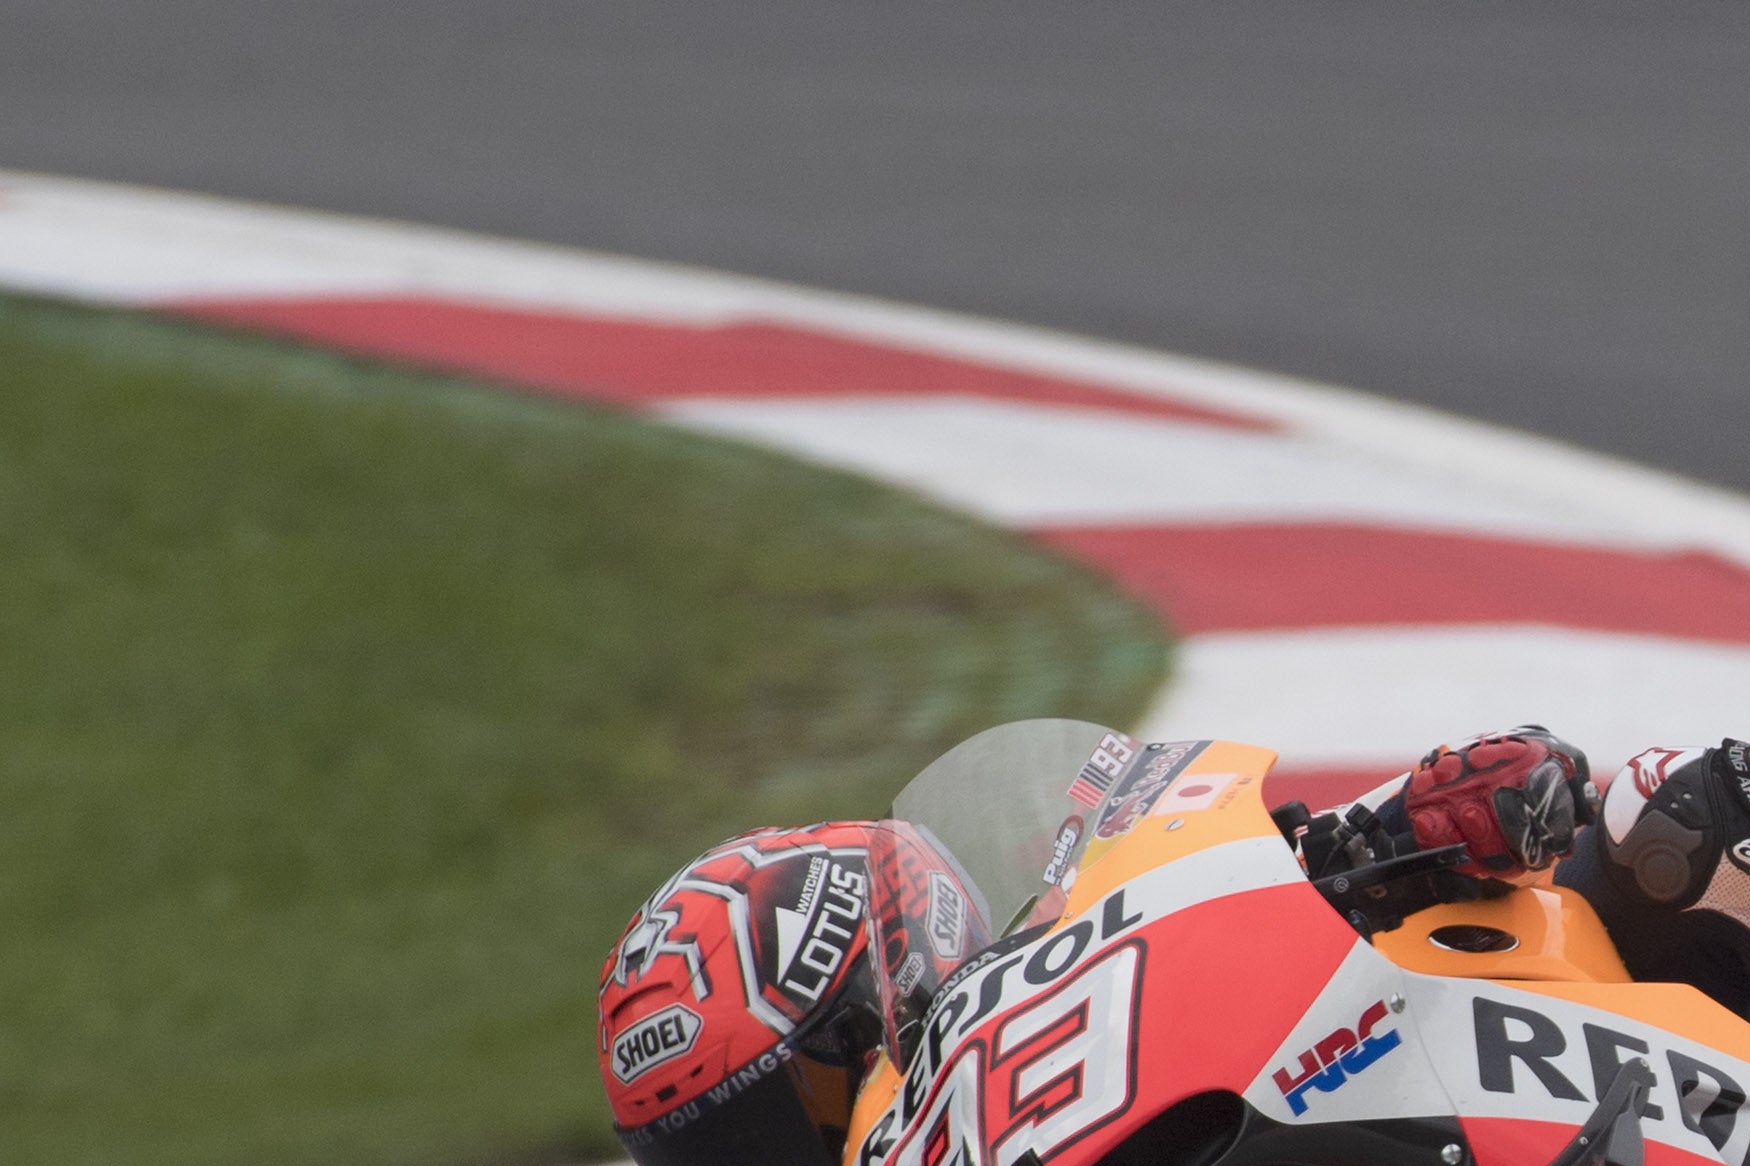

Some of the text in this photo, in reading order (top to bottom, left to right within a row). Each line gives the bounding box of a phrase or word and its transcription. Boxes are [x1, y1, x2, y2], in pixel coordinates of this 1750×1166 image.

[1093, 732, 1135, 777] 93
[796, 856, 824, 916] WATCHES
[1043, 827, 1077, 884] Puig
[785, 863, 864, 1001] LOTUS
[933, 881, 960, 951] SHOEI
[898, 956, 923, 994] SHOEI
[922, 951, 1000, 1028] HONDA
[616, 1013, 688, 1075] SHOEI
[1272, 999, 1402, 1117] HRC
[657, 1042, 792, 1133] YOU WINGS
